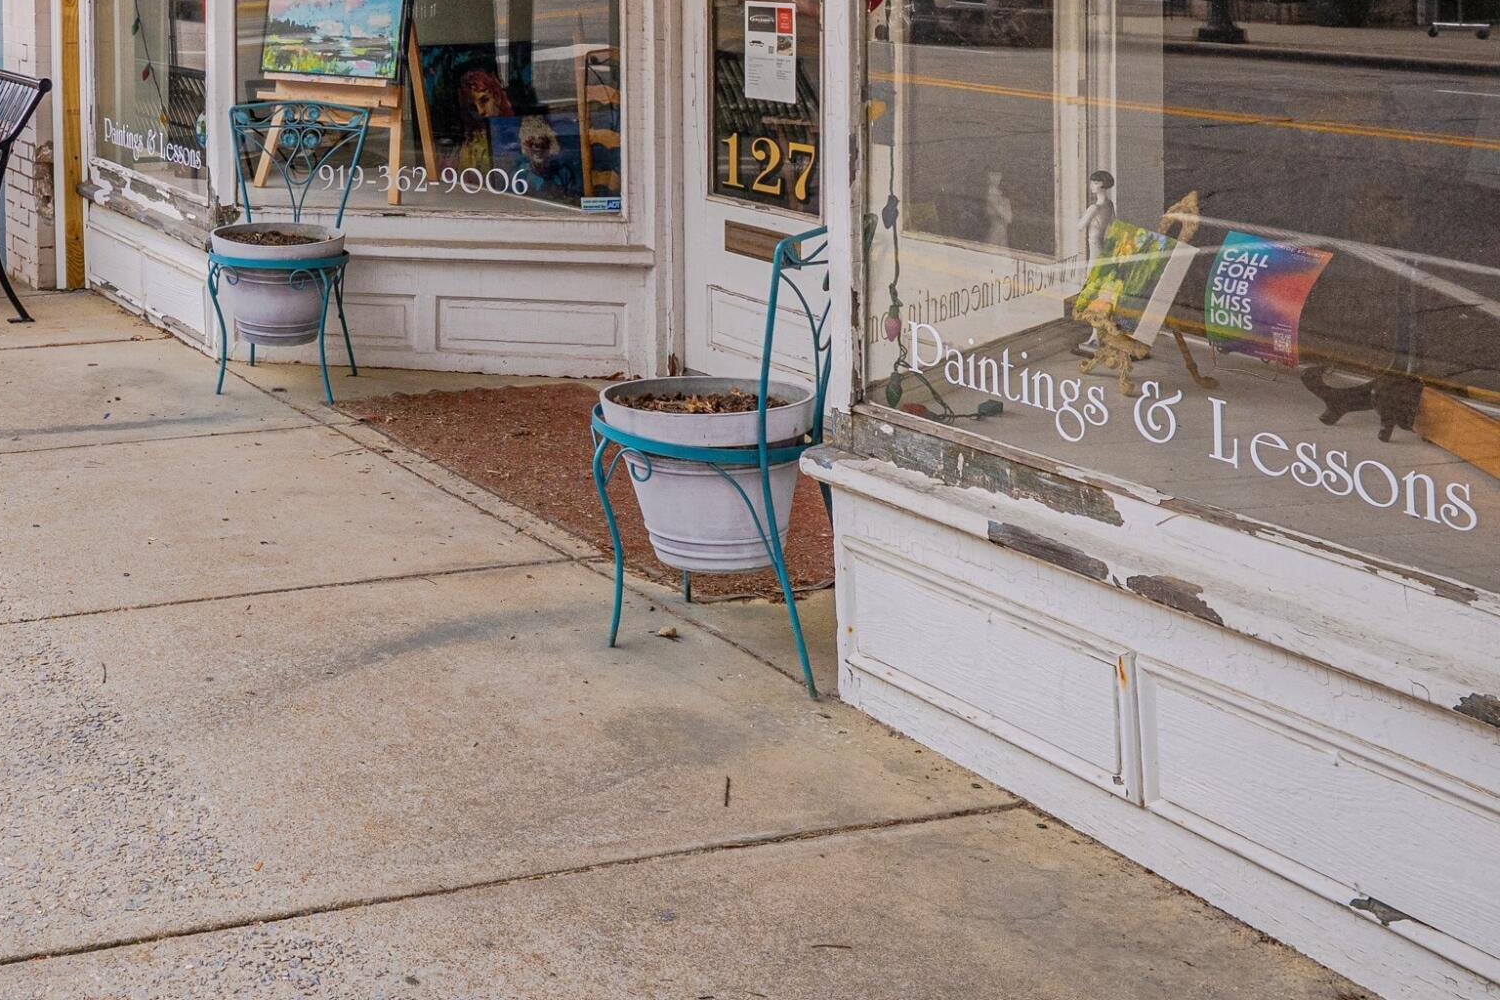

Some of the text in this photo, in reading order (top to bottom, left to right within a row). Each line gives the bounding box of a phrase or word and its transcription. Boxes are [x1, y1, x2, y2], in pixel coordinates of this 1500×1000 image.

[104, 118, 202, 169] Paintings & Lessons
[721, 132, 816, 201] 127
[318, 164, 529, 195] 919-362-9006
[1223, 247, 1269, 268] CALL
[1217, 261, 1258, 281] FOR
[1212, 276, 1249, 296] SUB
[1210, 291, 1251, 314] MISS
[1210, 308, 1253, 331] IONS
[908, 320, 1477, 532] Paintings & Lessons
